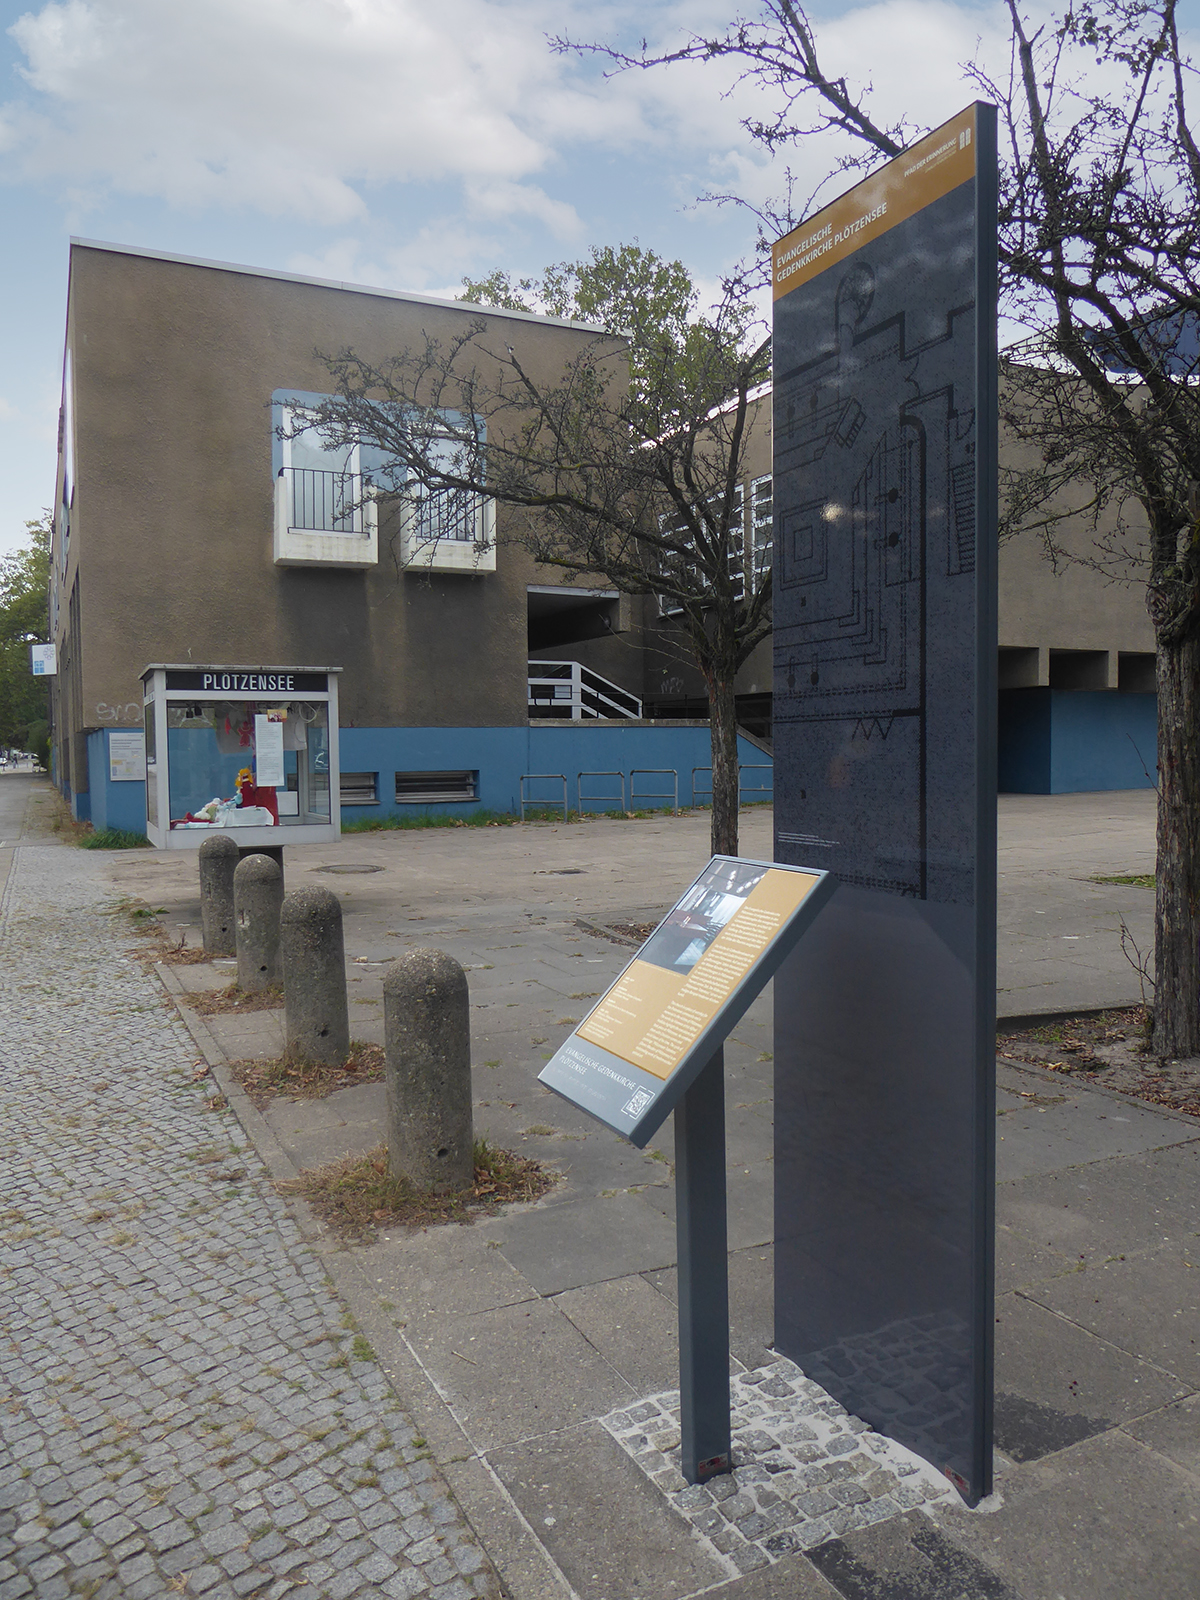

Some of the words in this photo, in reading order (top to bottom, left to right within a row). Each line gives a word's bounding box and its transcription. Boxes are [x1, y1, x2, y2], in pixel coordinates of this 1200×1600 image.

[916, 158, 927, 170] DER
[776, 241, 833, 283] GEDENKKIRCHE
[834, 202, 888, 246] PLÖTZENSEE
[776, 223, 833, 269] EVANGELISCHE
[203, 673, 295, 691] PLÖTZENSEE
[565, 1046, 600, 1070] EVANGELISCHE
[597, 1064, 637, 1090] GEDENKKIRCHE
